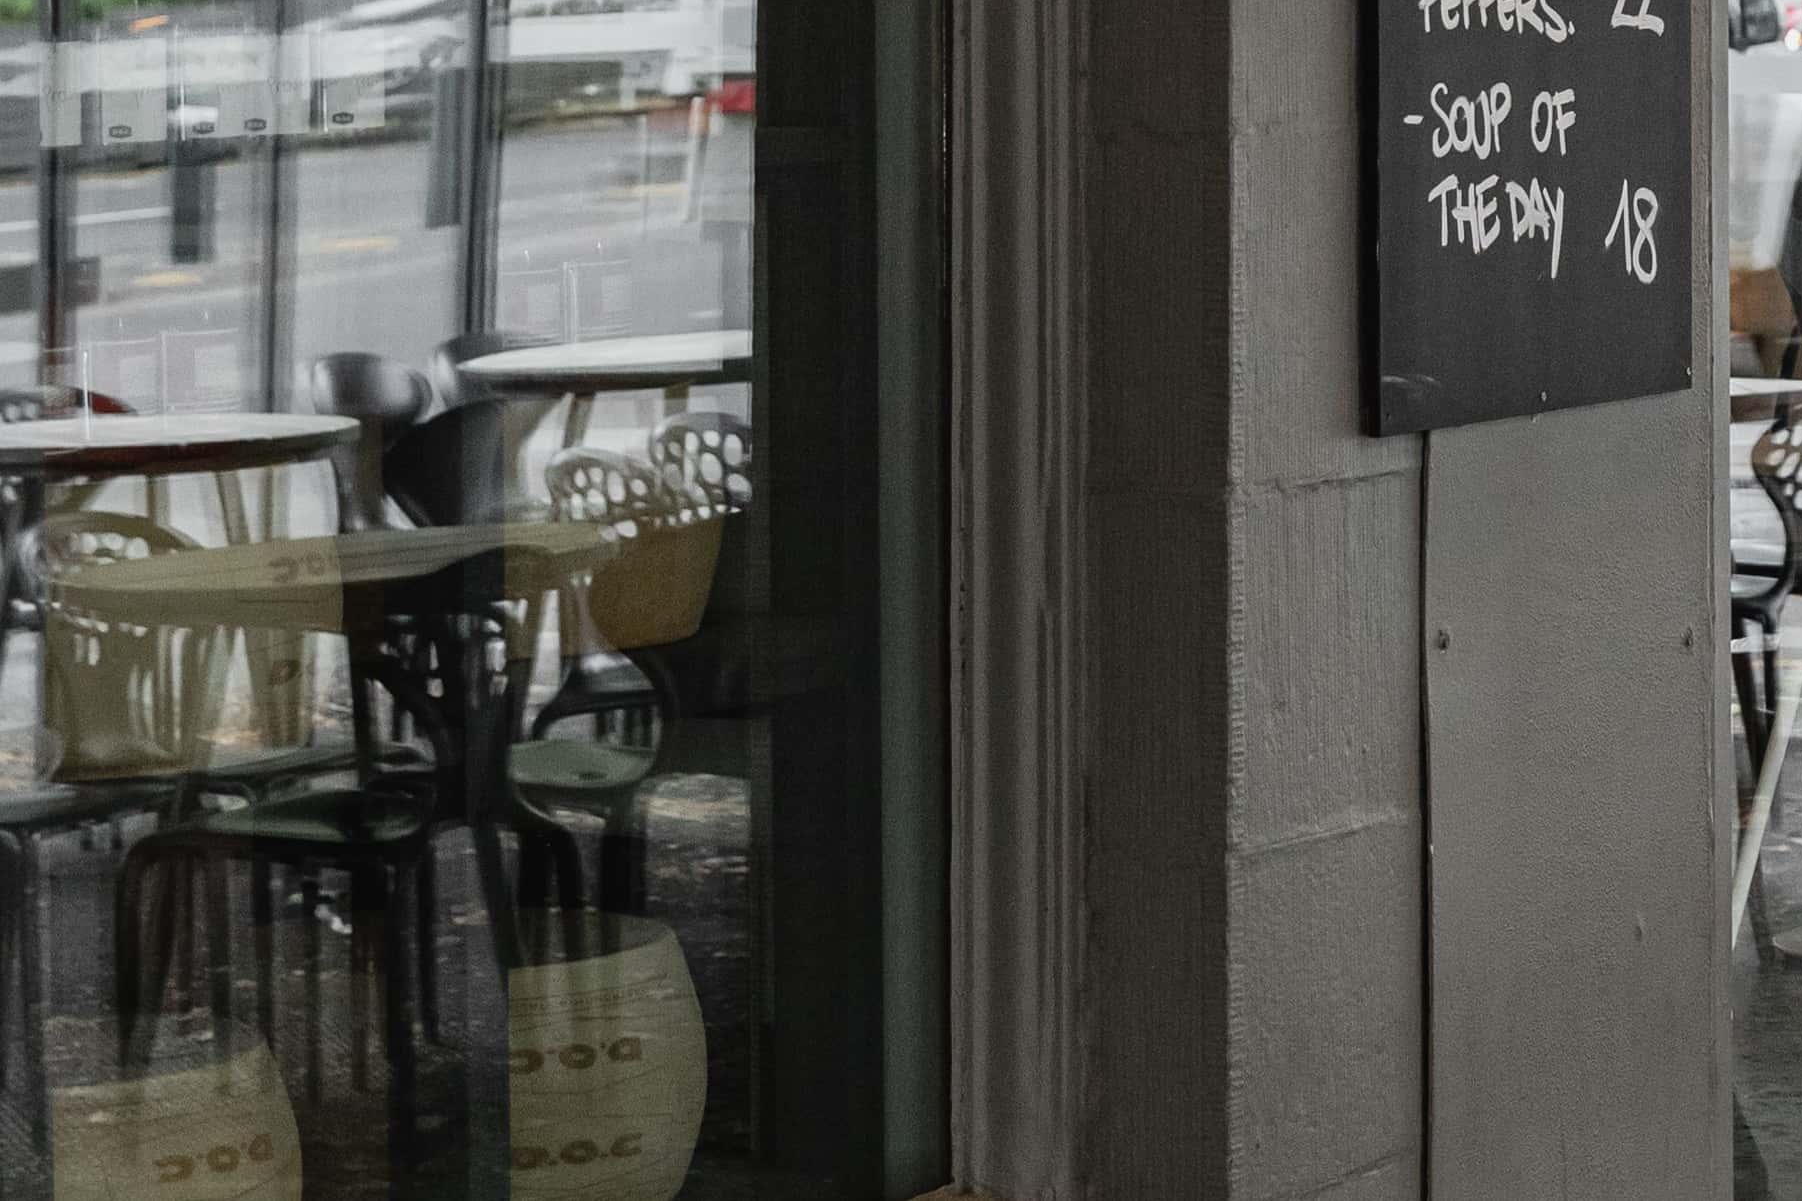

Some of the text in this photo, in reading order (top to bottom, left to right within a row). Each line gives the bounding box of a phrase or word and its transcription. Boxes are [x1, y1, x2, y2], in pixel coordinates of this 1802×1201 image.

[1531, 87, 1577, 156] OF
[1428, 173, 1659, 285] THE DAY 18
